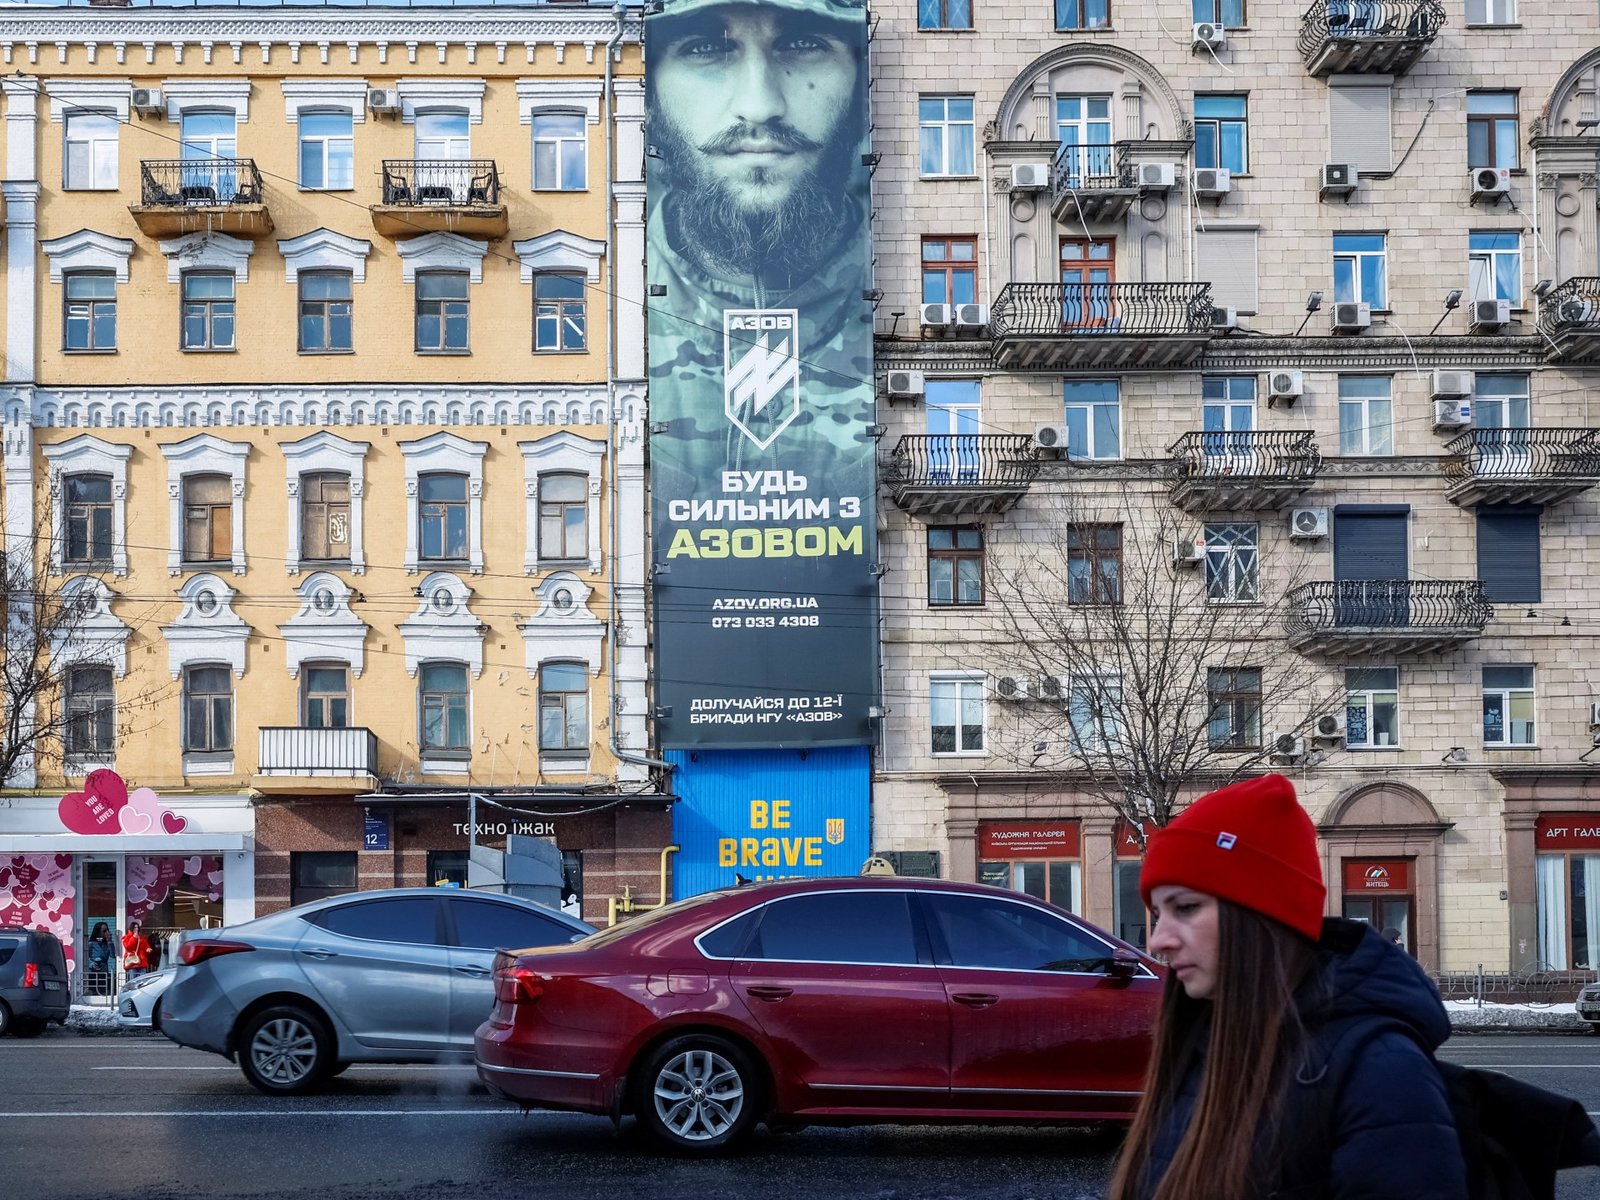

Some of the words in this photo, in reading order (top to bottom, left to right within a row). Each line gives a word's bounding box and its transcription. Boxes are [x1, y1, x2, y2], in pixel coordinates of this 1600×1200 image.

[731, 317, 792, 330] АЗОВ
[722, 470, 807, 495] БУДЬ
[668, 498, 829, 521] СИЛЬНИМ
[839, 497, 861, 518] З
[666, 525, 863, 559] АЗОВОМ
[712, 597, 819, 610] AZOV.ORG.UA
[712, 617, 741, 628] 073
[745, 616, 775, 628] 033
[779, 615, 819, 627] 4308
[690, 696, 784, 711] ДОЛУЧАЙСЯ
[787, 697, 810, 710] ДО
[813, 694, 843, 708] 12-Ї
[690, 713, 753, 725] БРИГАДИ
[757, 712, 783, 723] НГУ
[85, 795, 98, 807] YOU
[92, 802, 105, 815] ARE
[750, 800, 791, 829] BE
[96, 808, 115, 825] LOVED
[991, 831, 1030, 839] ХУДОЖНЯ
[1546, 827, 1569, 837] АРТ
[365, 833, 378, 845] 12
[1126, 834, 1149, 844] АТ
